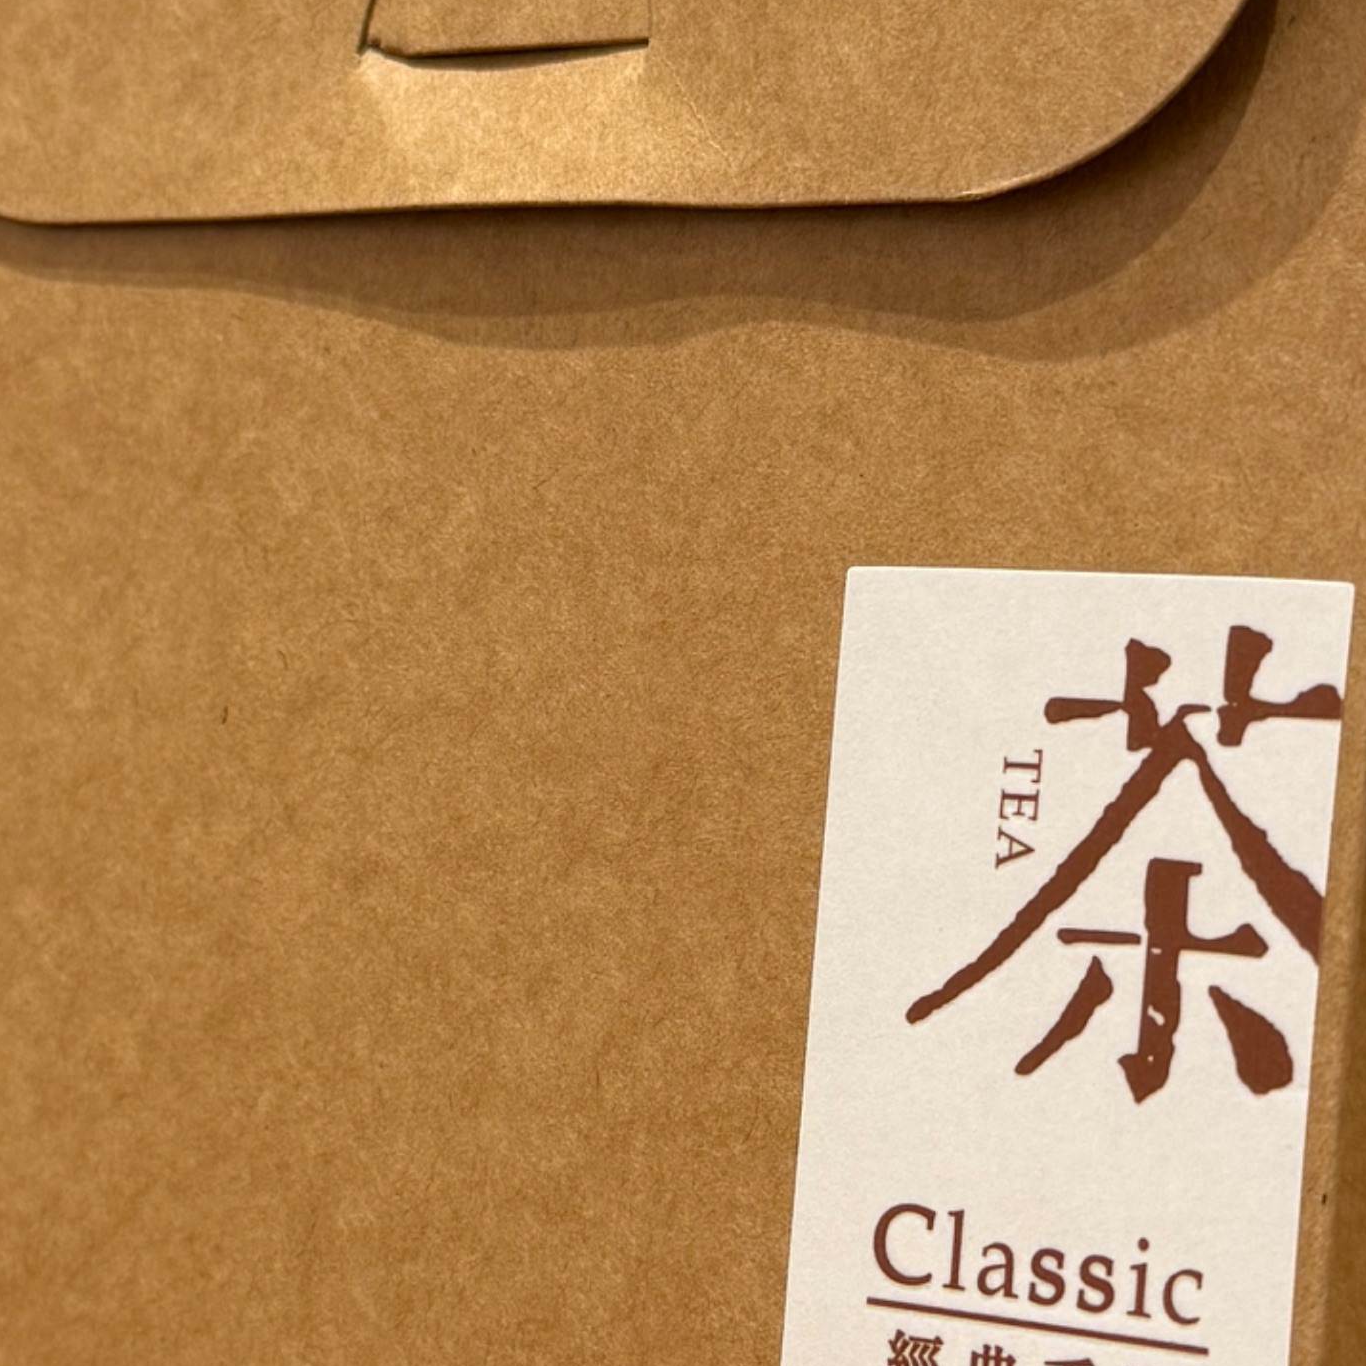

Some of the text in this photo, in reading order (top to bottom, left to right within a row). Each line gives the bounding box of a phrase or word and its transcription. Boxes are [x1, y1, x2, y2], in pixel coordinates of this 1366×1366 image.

[906, 625, 1342, 1103] 茶
[995, 749, 1043, 868] TEA
[872, 1203, 1204, 1325] Classic
